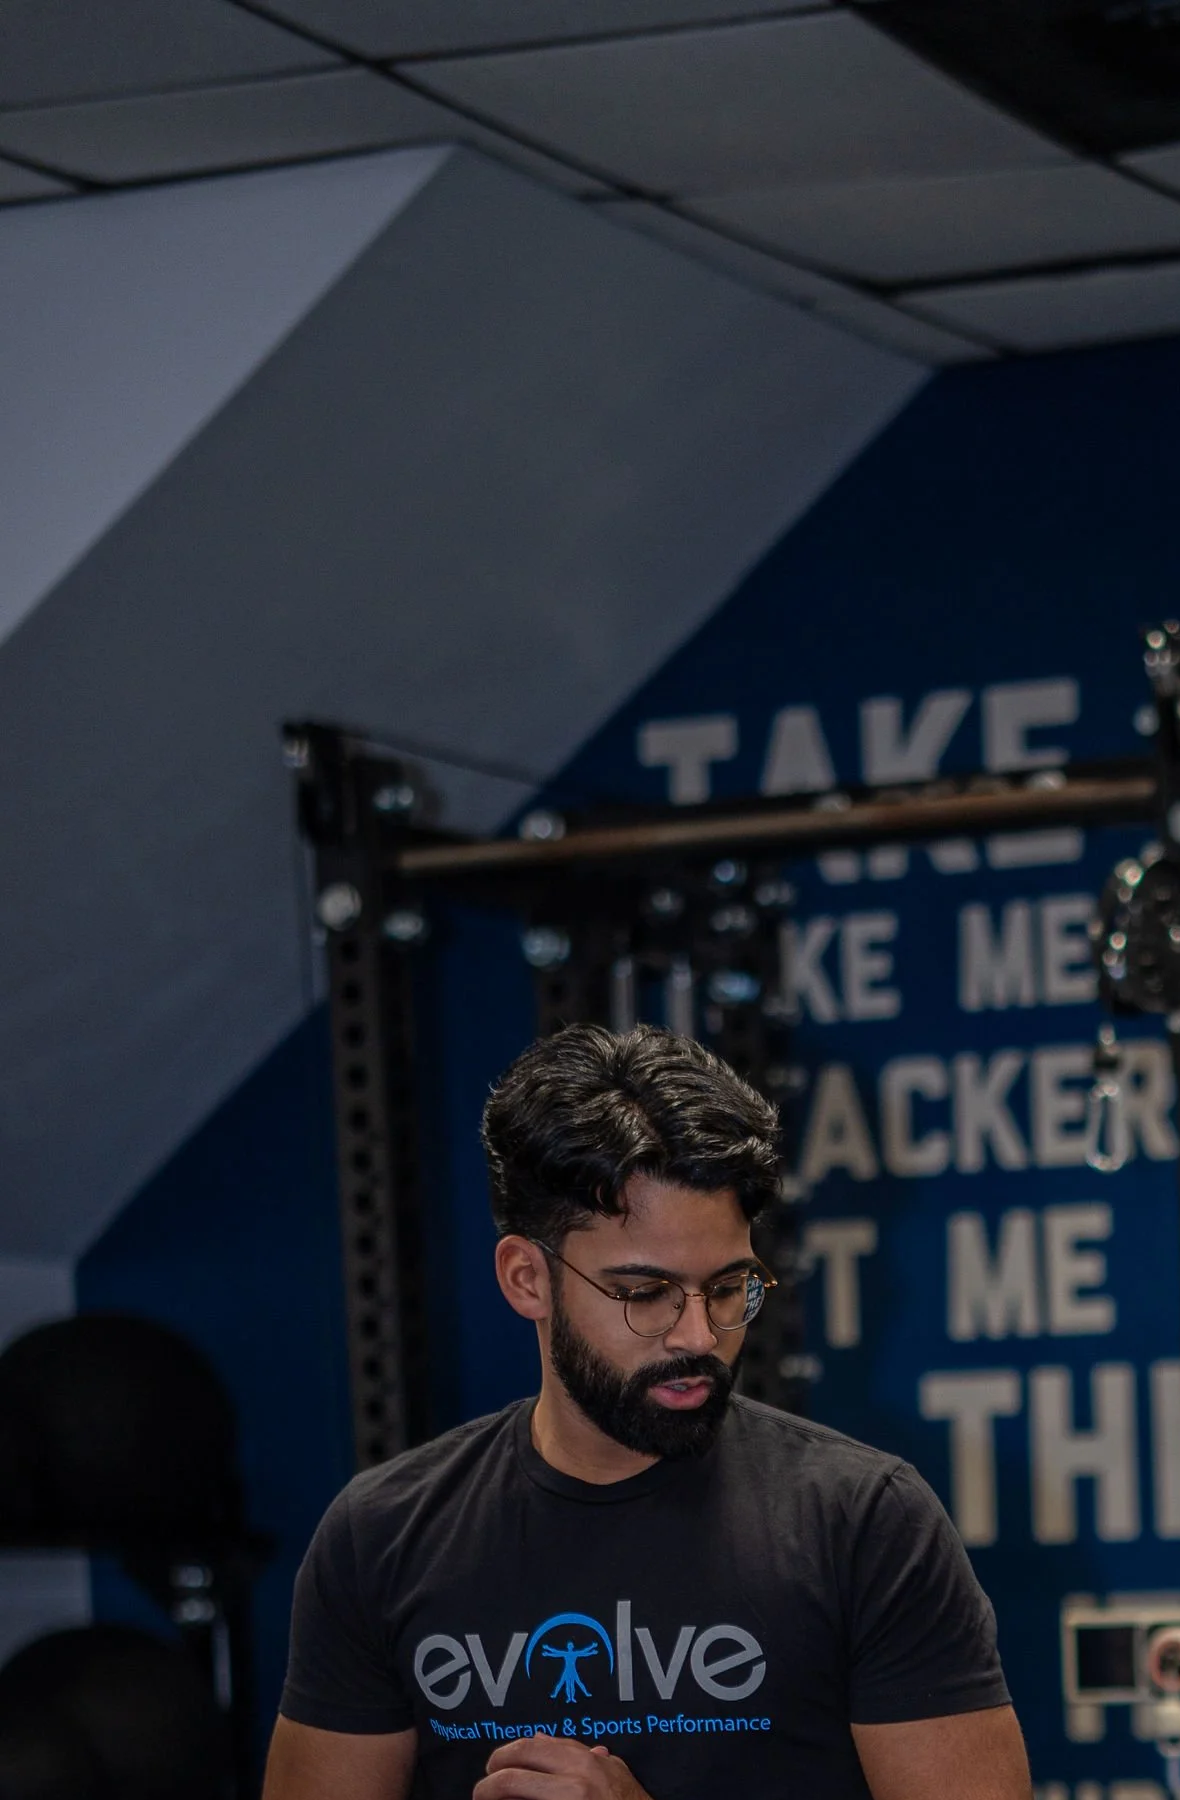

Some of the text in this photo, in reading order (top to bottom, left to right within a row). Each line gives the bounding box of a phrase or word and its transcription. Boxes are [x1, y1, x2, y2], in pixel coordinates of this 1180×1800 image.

[944, 1200, 1119, 1344] ME
[562, 1717, 577, 1736] &
[581, 1716, 642, 1740] Sports
[646, 1713, 771, 1734] Performance
